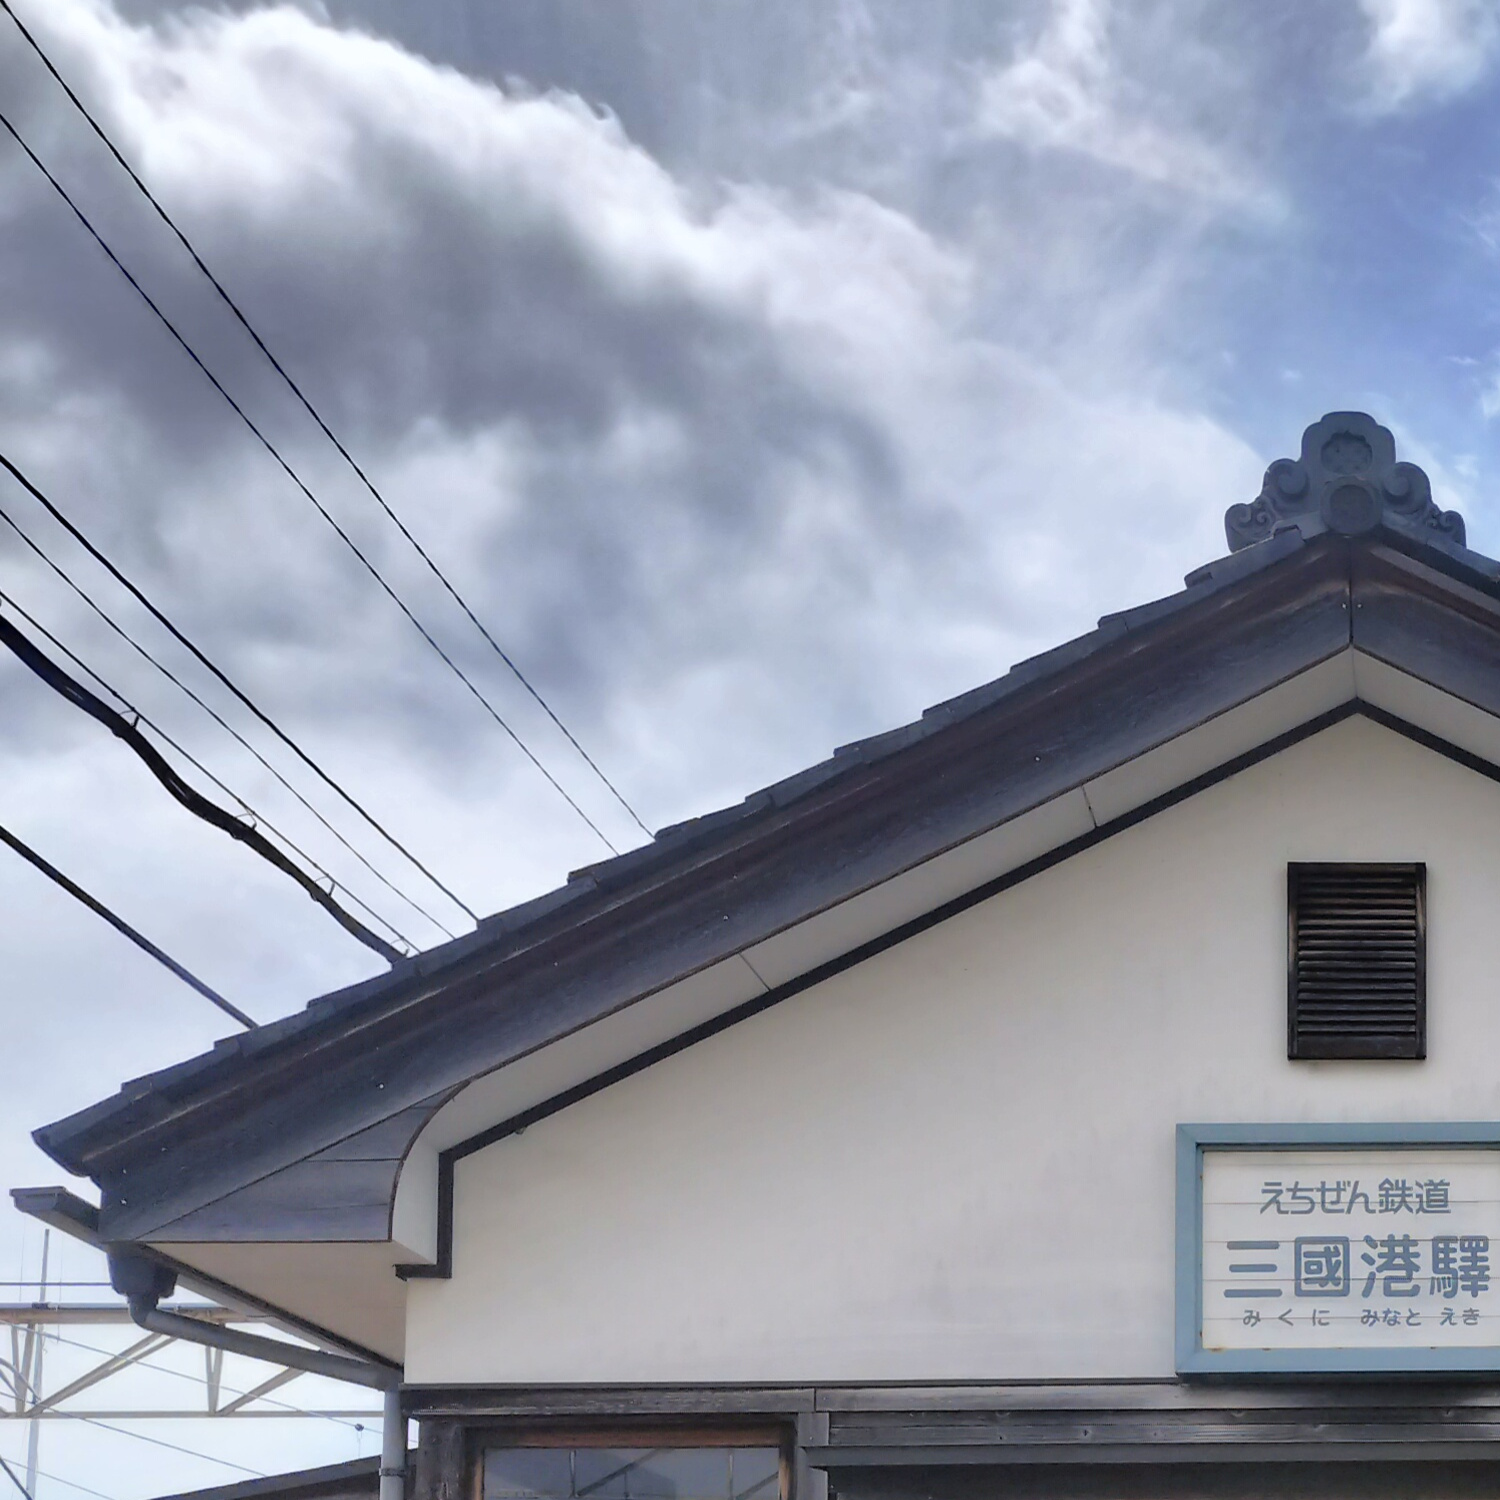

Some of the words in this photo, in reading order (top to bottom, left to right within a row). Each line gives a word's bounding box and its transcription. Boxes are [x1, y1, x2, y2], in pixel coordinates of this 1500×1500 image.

[1260, 1177, 1451, 1215] えちぜん鉄道
[1223, 1234, 1491, 1299] 三國港驛
